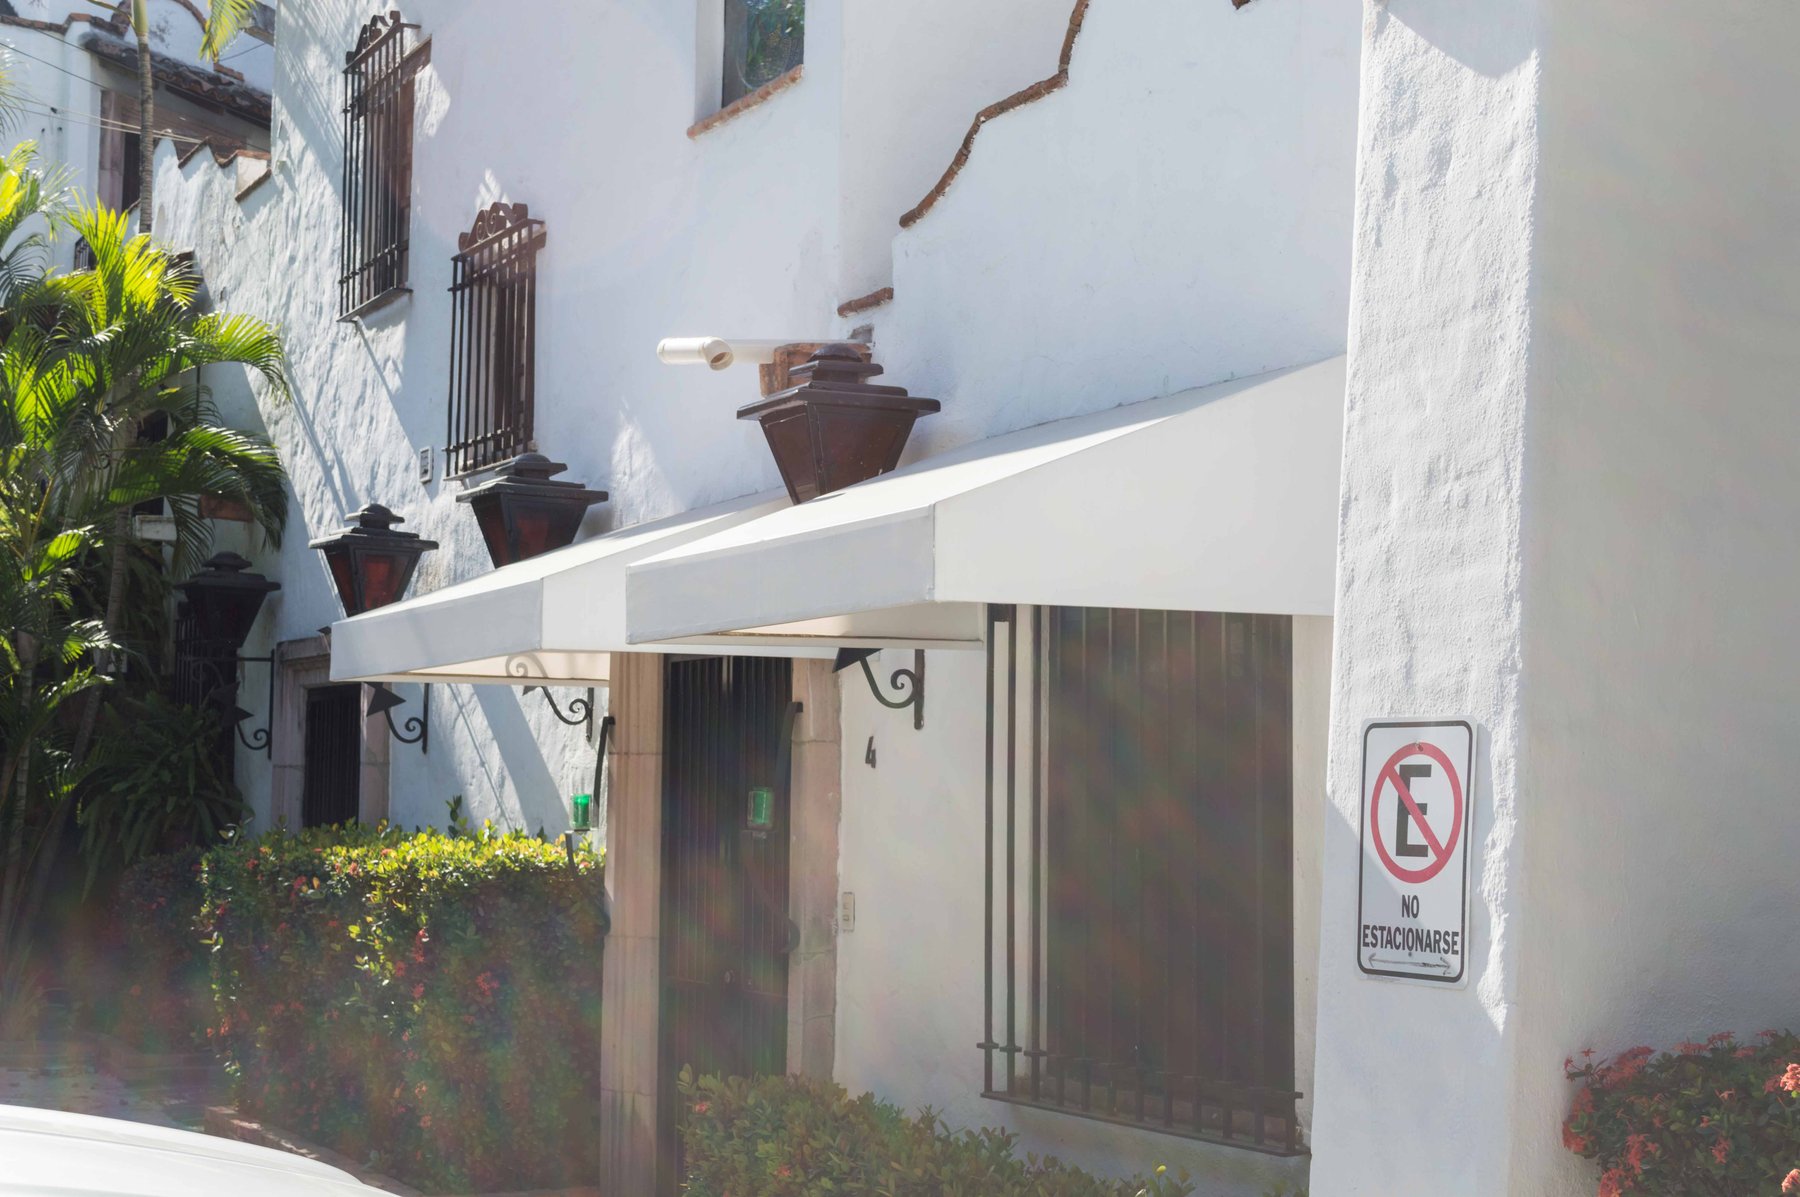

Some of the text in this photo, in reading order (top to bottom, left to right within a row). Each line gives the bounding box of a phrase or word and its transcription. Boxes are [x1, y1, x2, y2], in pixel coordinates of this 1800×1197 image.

[865, 735, 876, 768] 4
[1395, 764, 1431, 857] E
[1401, 894, 1419, 918] NO
[1362, 924, 1459, 955] ESTACIONARSE
